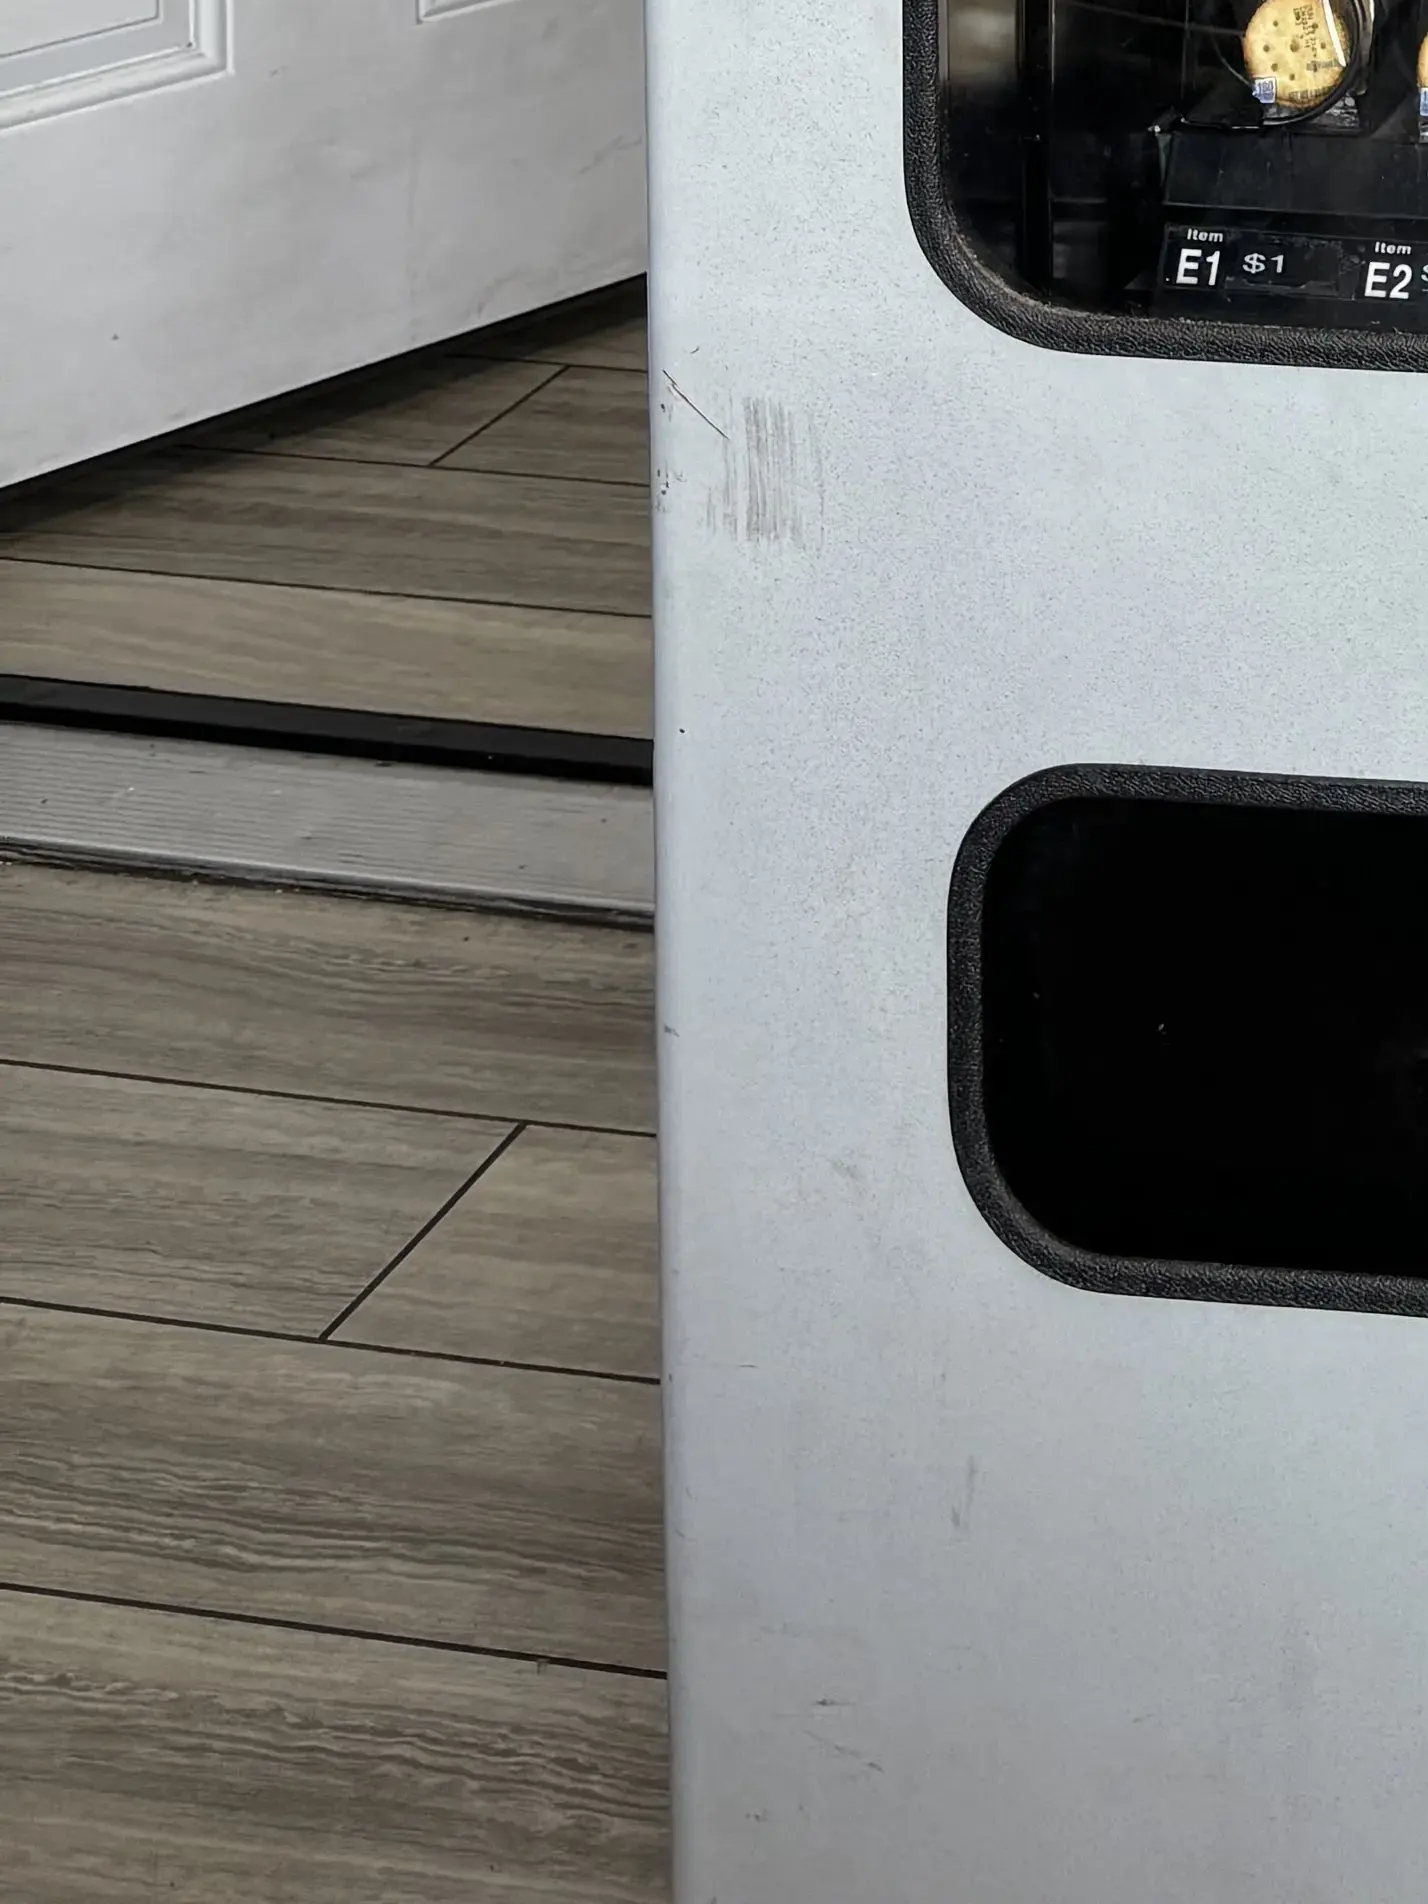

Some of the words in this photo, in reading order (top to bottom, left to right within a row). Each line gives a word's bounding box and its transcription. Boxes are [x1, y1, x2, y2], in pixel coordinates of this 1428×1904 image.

[1176, 249, 1221, 286] E1
[1242, 252, 1286, 274] $1
[1364, 262, 1413, 299] E2
